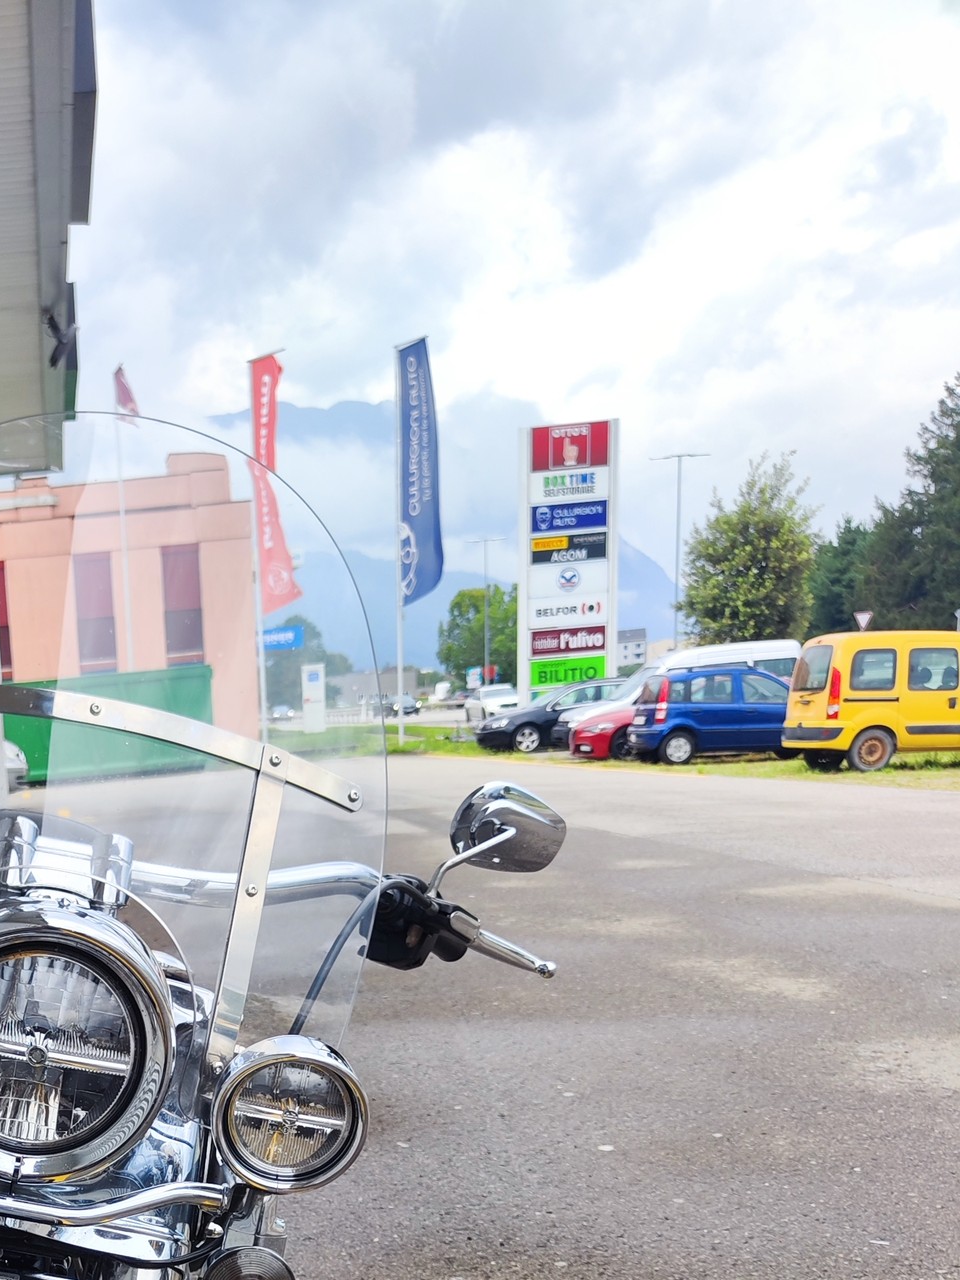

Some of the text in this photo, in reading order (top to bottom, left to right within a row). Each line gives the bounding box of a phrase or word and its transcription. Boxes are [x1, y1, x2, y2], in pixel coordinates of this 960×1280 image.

[407, 356, 419, 406] AUTO
[551, 548, 588, 562] AGOM
[535, 606, 578, 618] BELFOR
[538, 666, 597, 684] BILITIO
